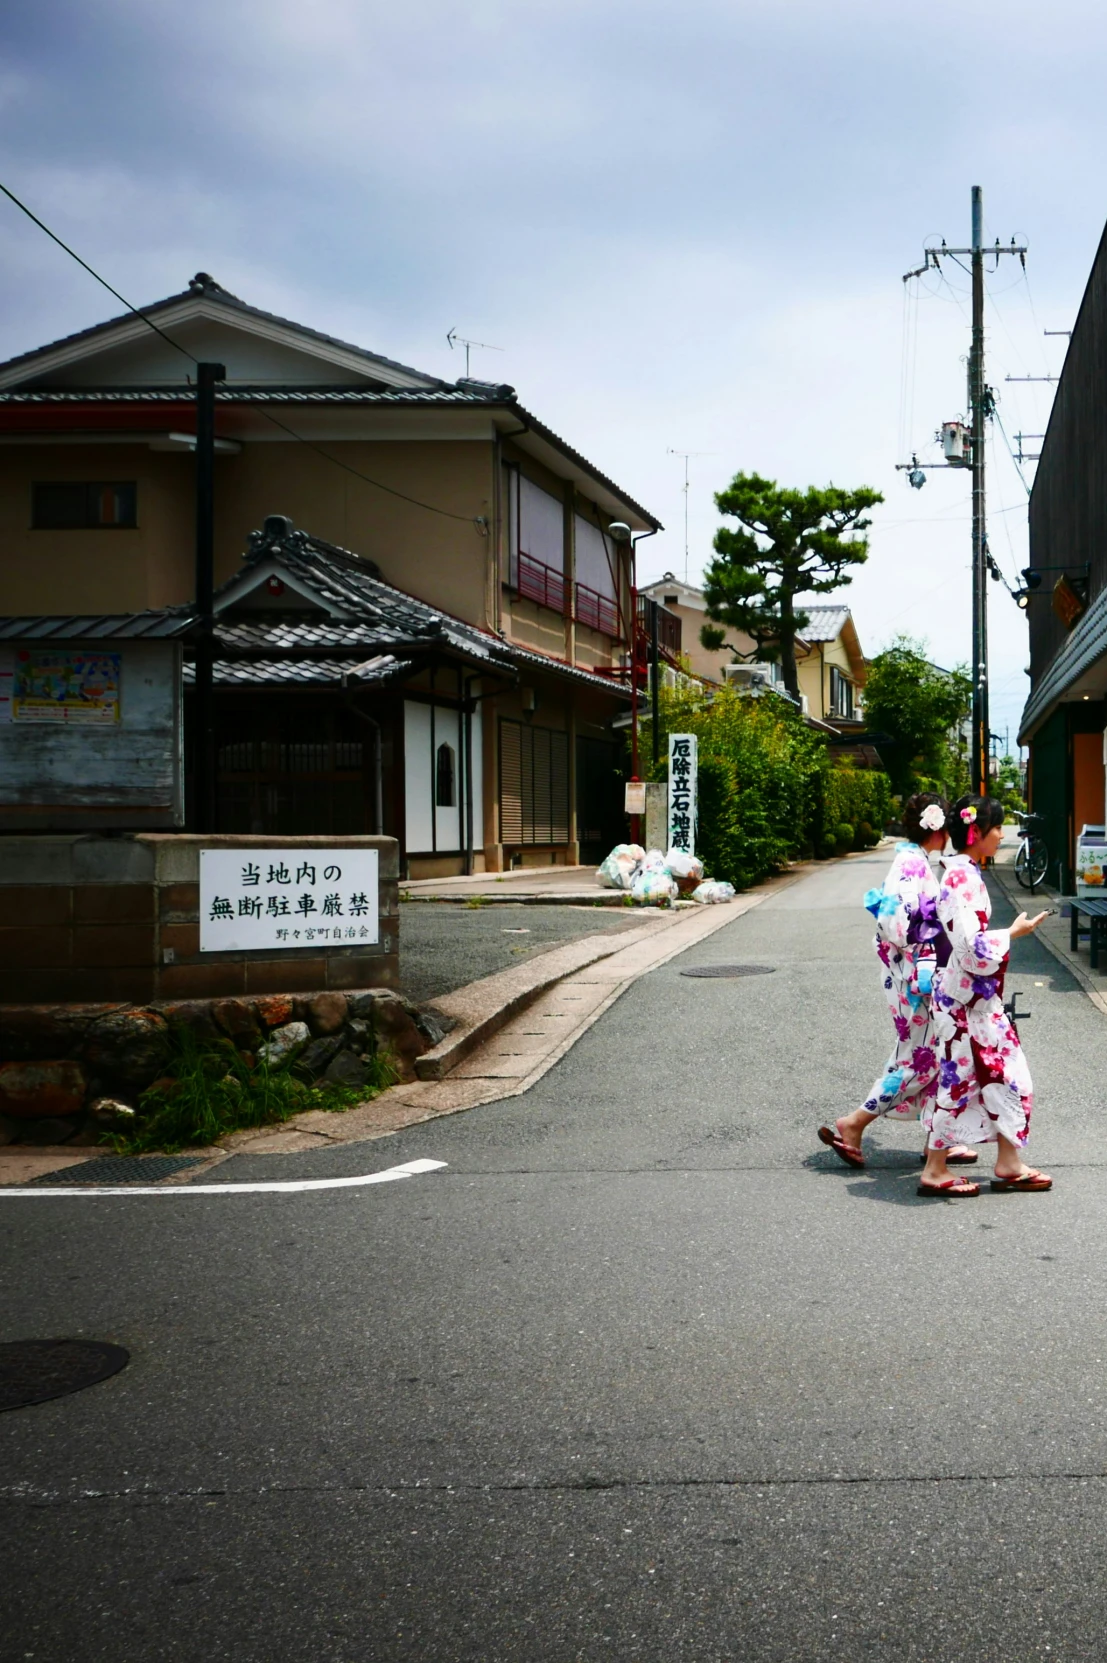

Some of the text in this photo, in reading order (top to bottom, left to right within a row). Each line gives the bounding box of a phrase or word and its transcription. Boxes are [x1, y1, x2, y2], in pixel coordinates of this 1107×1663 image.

[670, 738, 692, 853] 厄除立石地蔵
[241, 861, 342, 886] 当地内の
[208, 892, 370, 921] 無断駐車厳禁
[275, 925, 370, 941] 野々宮町自治会
